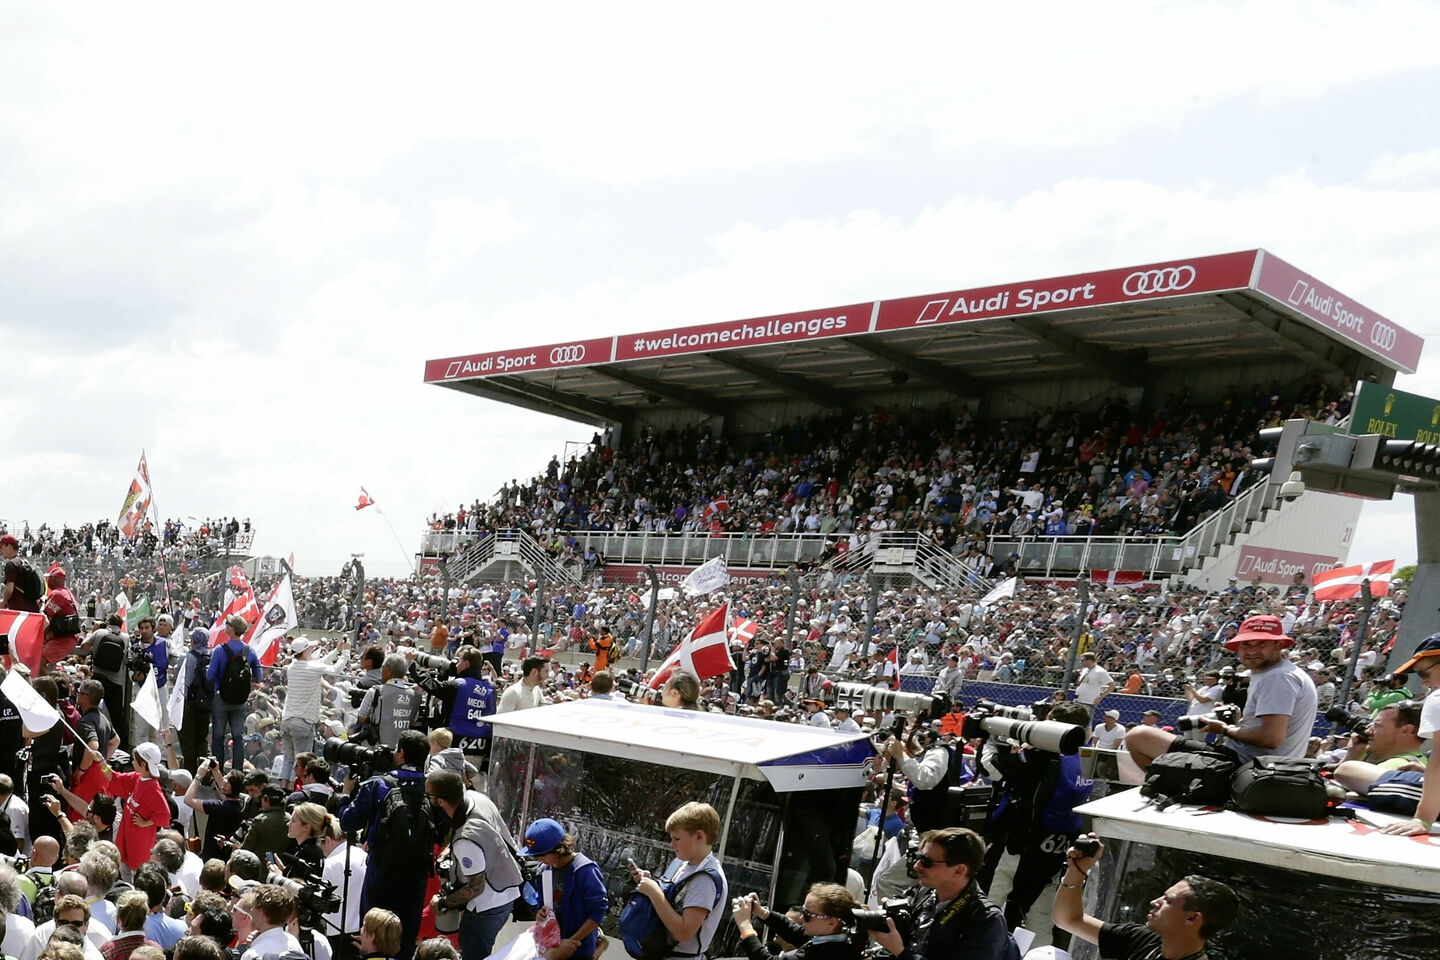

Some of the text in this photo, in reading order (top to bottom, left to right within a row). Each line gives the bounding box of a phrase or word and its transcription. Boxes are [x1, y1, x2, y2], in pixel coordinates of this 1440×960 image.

[949, 281, 1096, 315] Audi Sport
[1304, 286, 1364, 334] Audi Sport
[633, 313, 848, 353] #welcomechallenges
[461, 353, 536, 373] Audi Sport
[1367, 418, 1398, 438] ROLEX
[1342, 527, 1352, 543] 21
[1252, 557, 1305, 576] Audi Sport
[563, 709, 769, 749] TOYOTA
